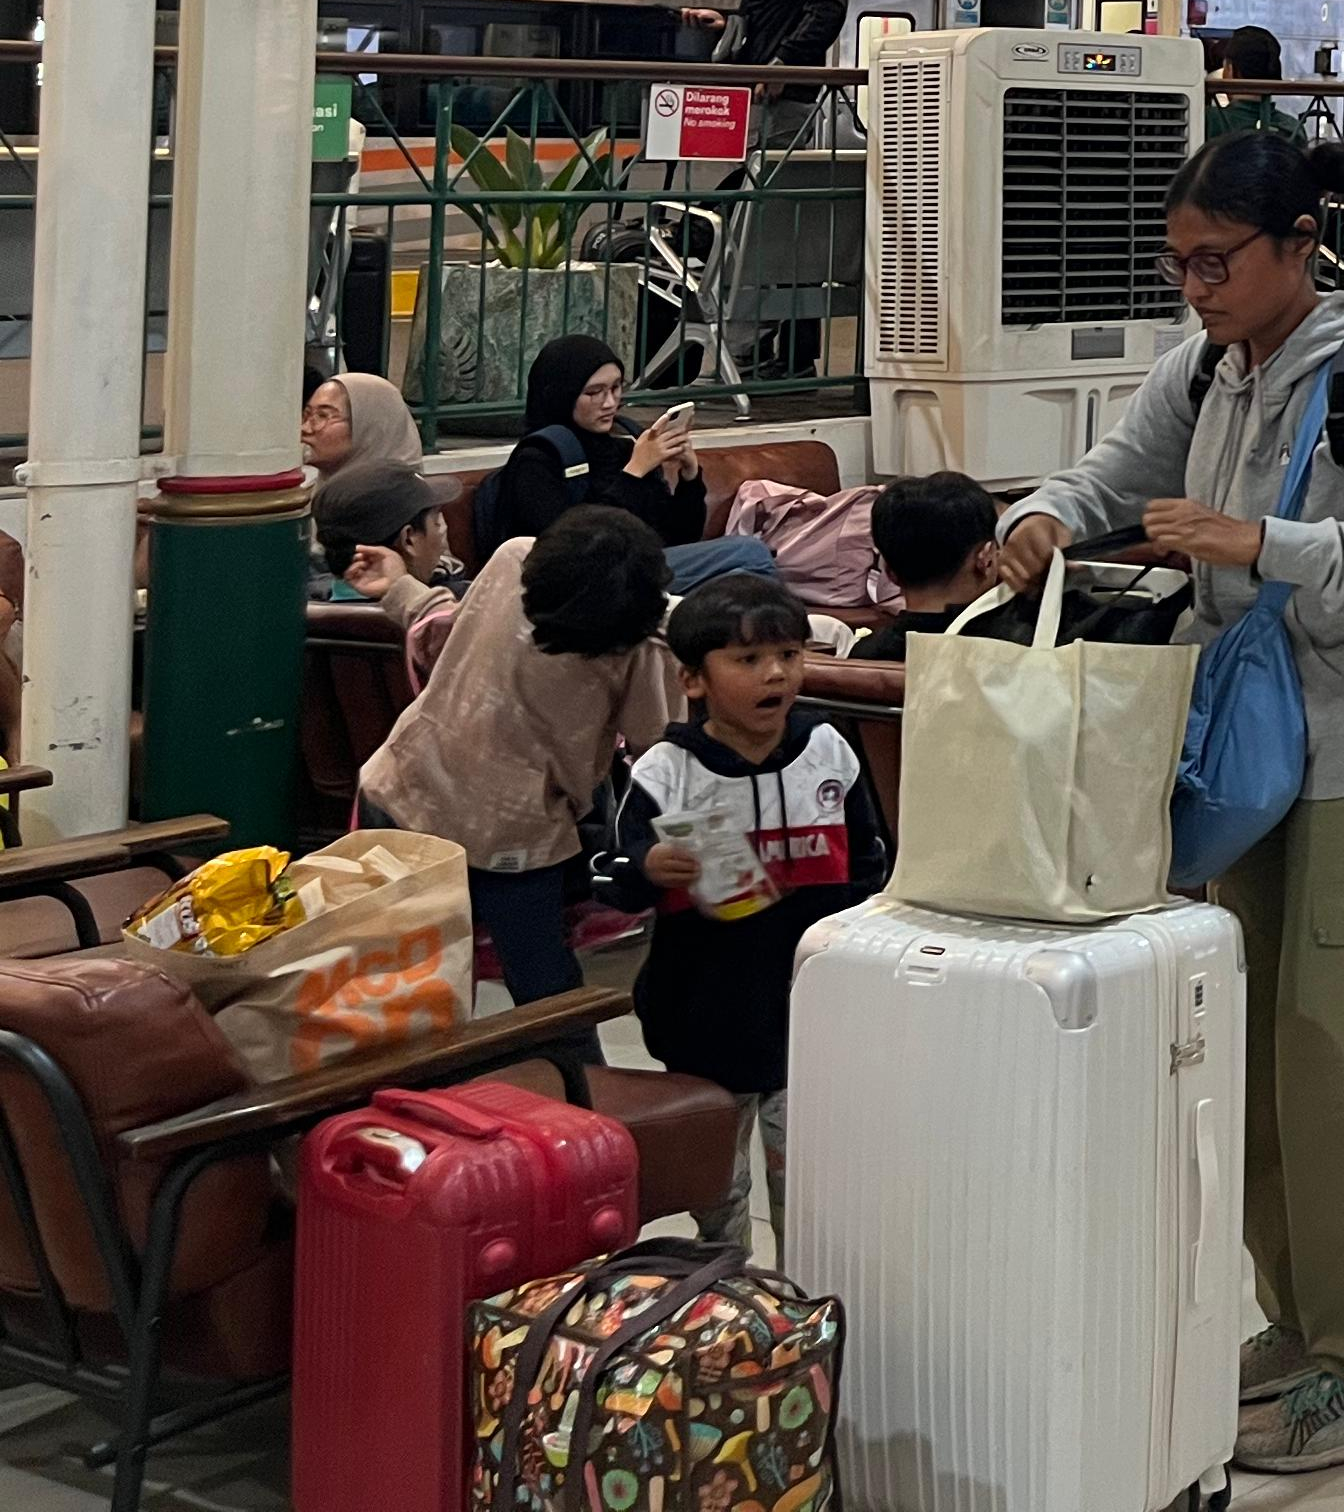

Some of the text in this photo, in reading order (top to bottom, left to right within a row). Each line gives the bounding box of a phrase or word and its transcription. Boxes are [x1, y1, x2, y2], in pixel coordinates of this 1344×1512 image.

[686, 91, 729, 105] Dilarang
[312, 103, 337, 118] asi
[685, 106, 729, 116] merokok
[683, 117, 736, 130] No smoking
